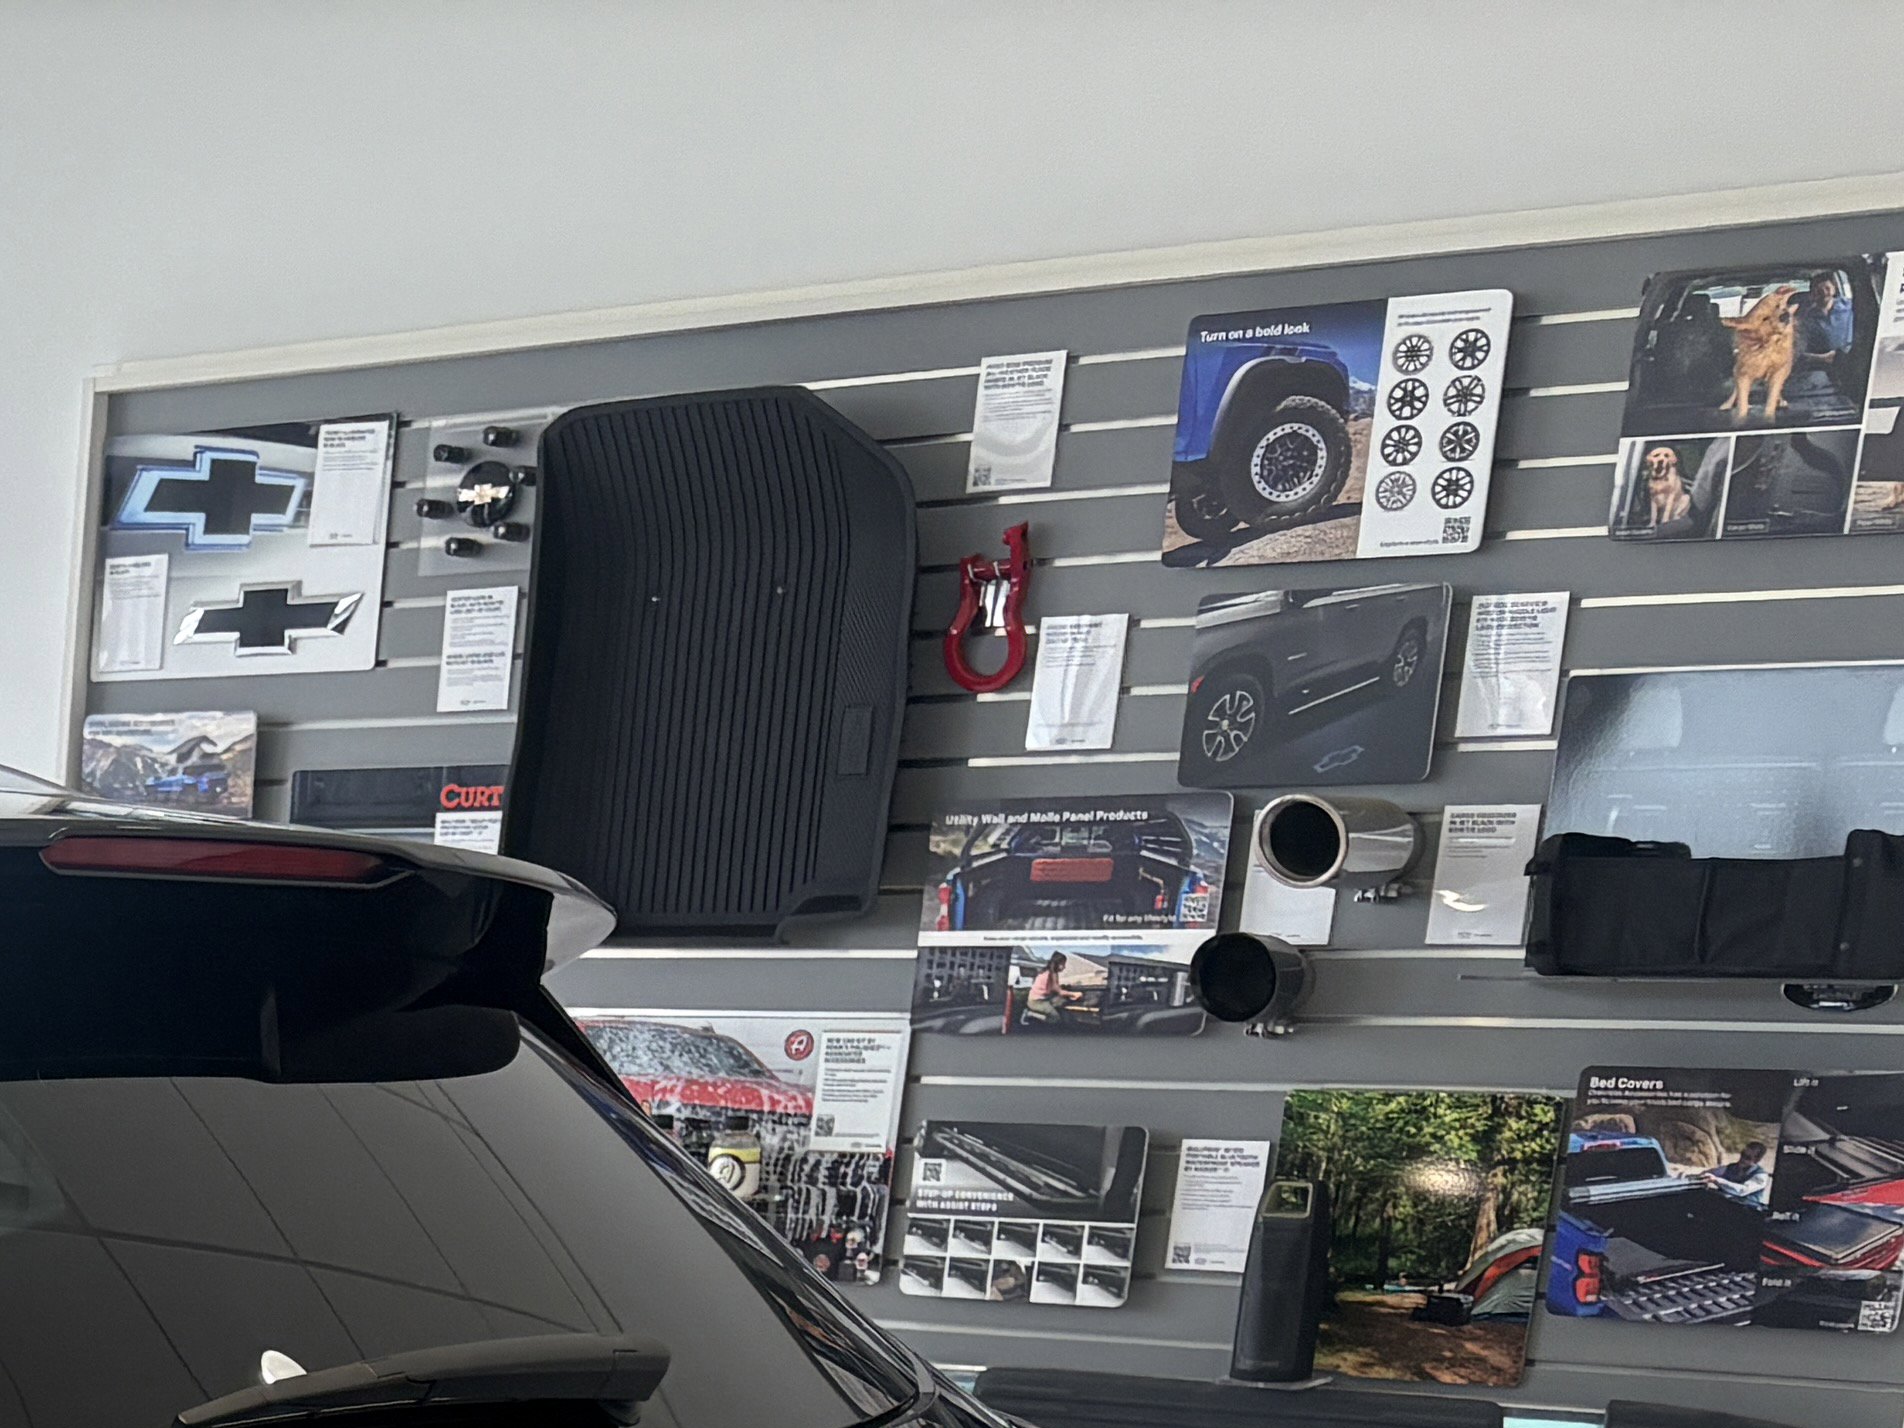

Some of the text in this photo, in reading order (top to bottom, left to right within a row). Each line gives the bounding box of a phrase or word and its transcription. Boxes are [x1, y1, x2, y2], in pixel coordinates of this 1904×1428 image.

[1199, 322, 1310, 344] Turn on a bold look
[439, 783, 505, 809] CURT
[945, 813, 979, 827] Utility
[981, 813, 1006, 825] Wall
[1007, 813, 1028, 824] and
[1062, 811, 1093, 822] Panel
[1096, 809, 1148, 822] Products
[1589, 1076, 1664, 1090] Bed Covers
